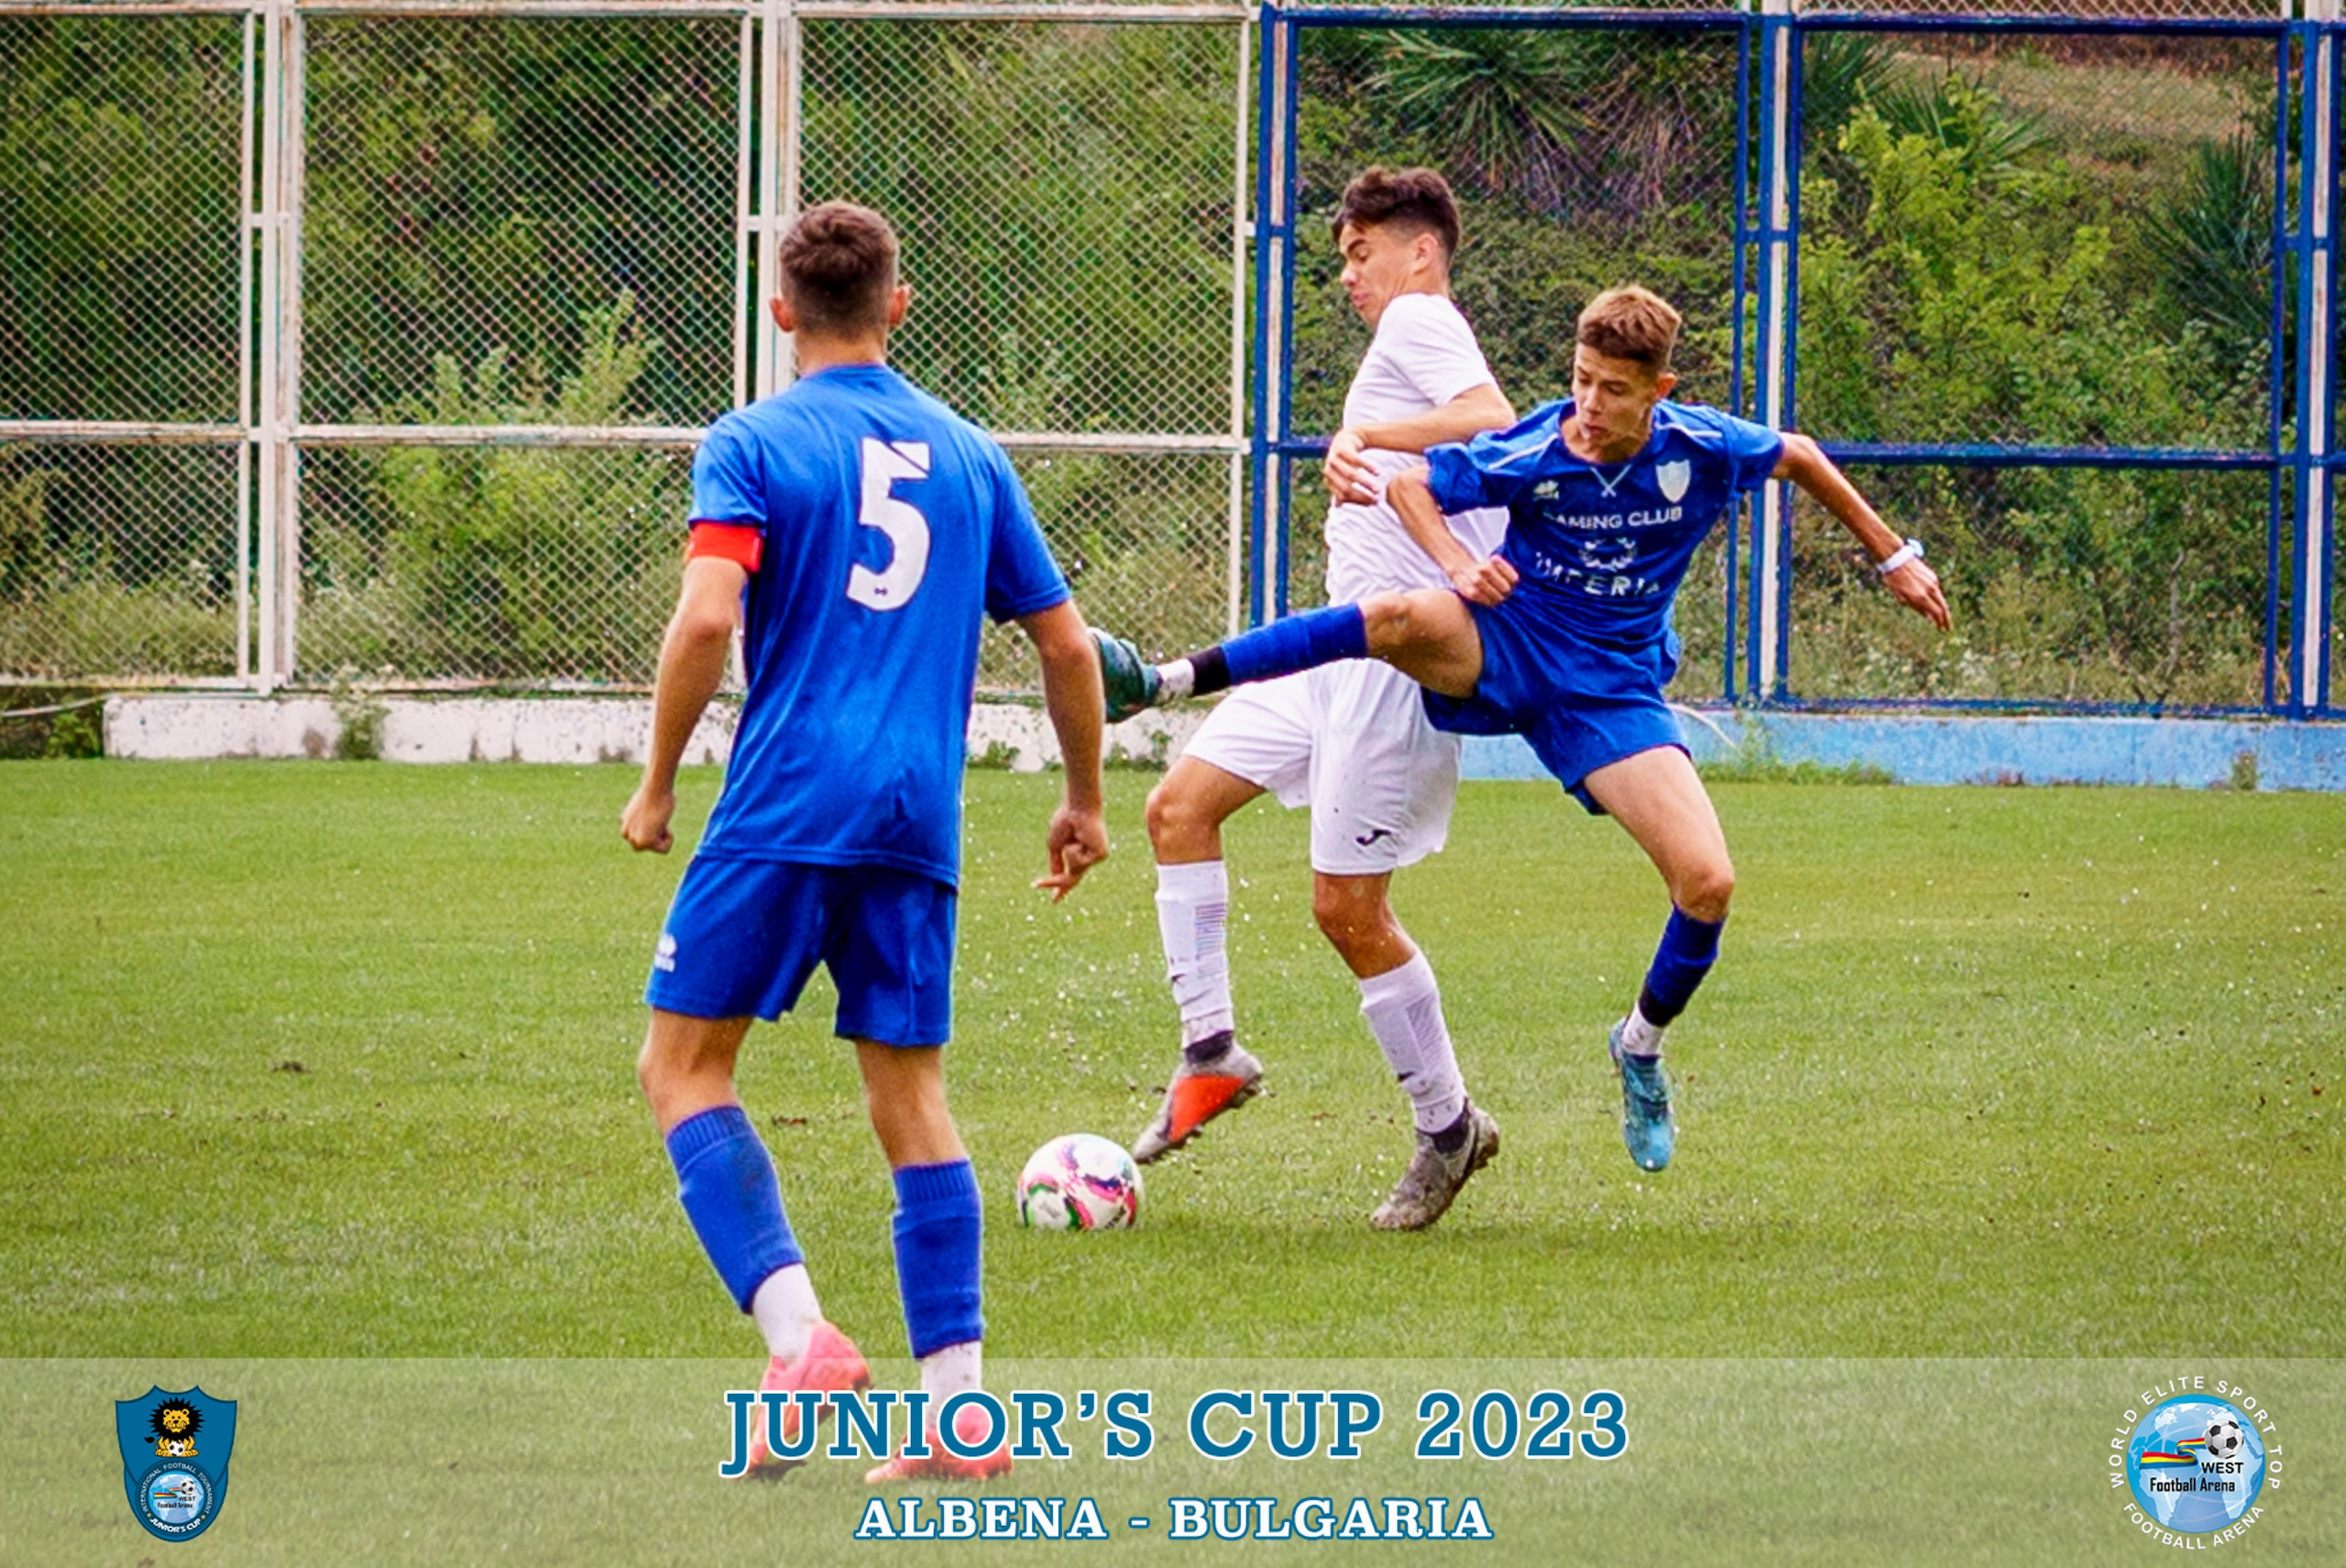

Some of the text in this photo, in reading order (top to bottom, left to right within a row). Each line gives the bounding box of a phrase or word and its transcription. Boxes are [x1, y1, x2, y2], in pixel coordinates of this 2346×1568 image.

[847, 436, 931, 612] 5
[1542, 506, 1683, 529] AMING CLUB
